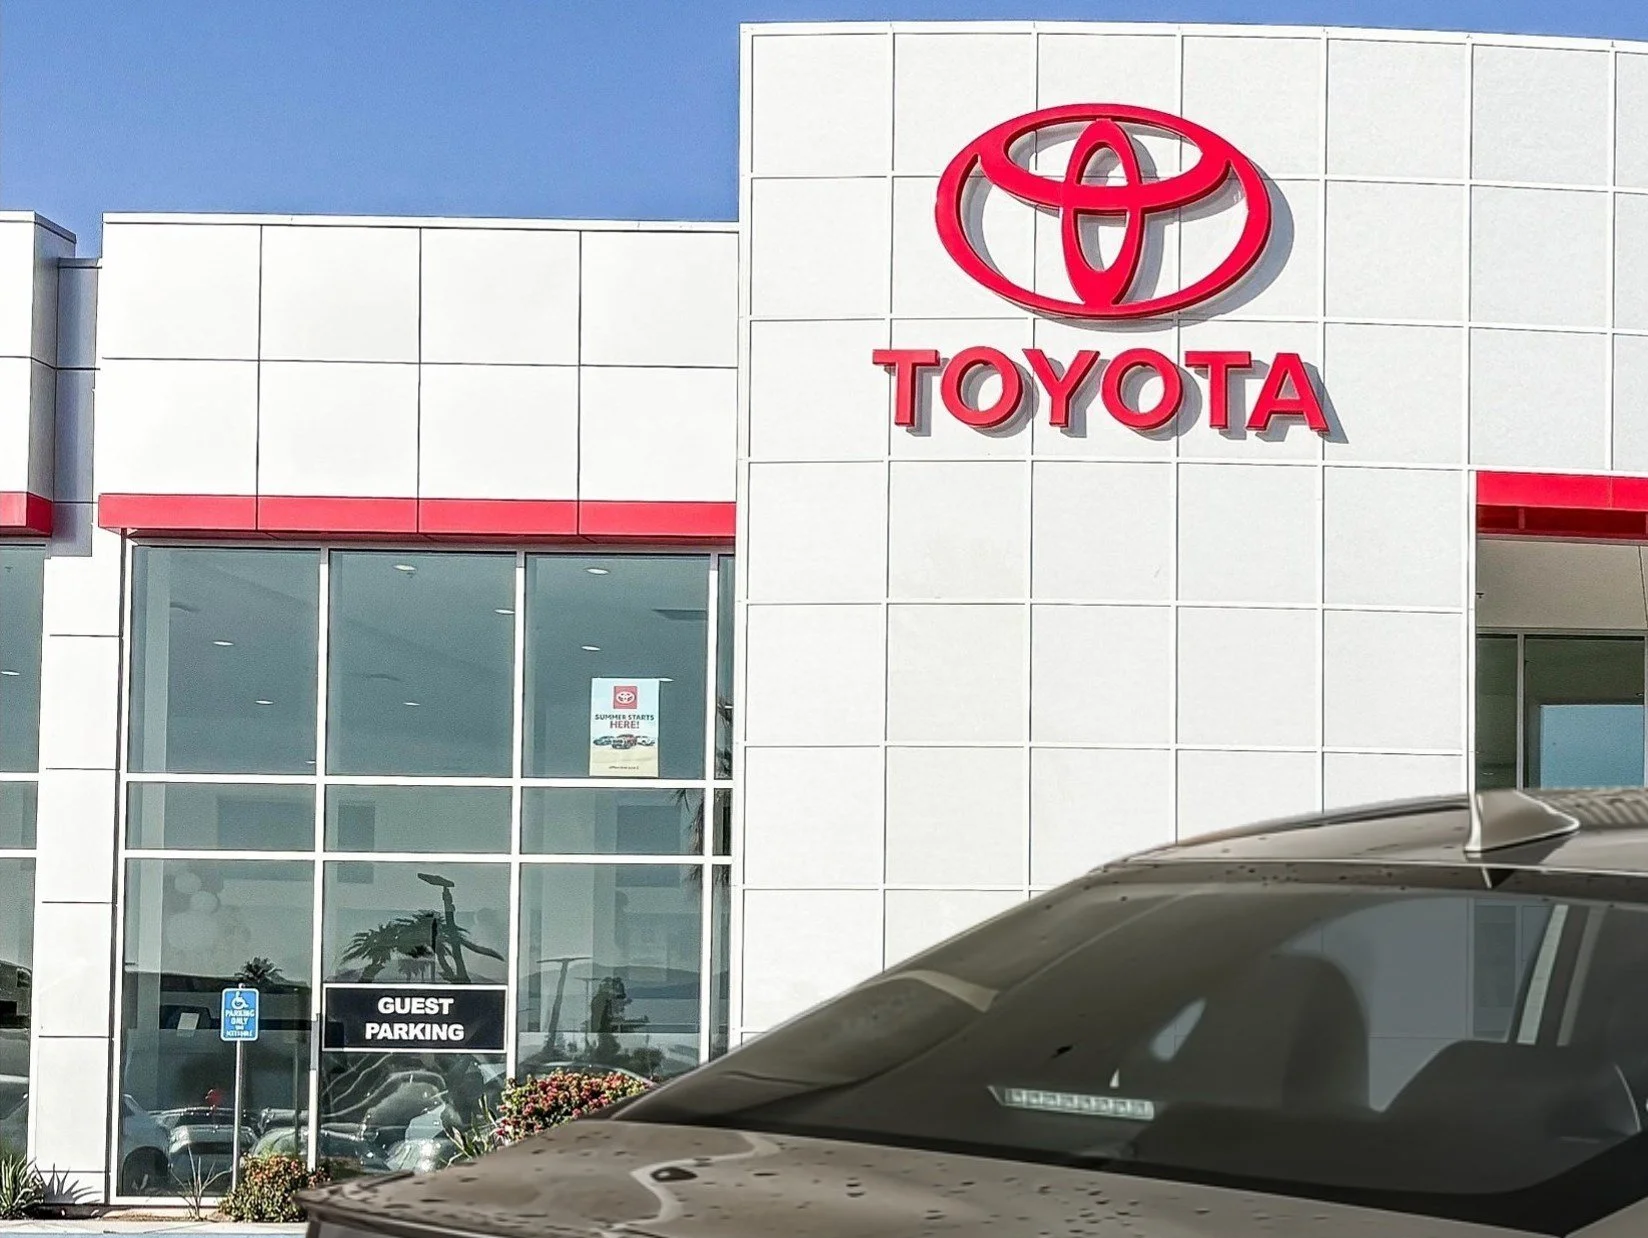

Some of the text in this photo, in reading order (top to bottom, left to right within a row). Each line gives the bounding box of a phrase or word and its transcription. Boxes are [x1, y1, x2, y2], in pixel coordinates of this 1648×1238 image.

[873, 345, 1330, 433] TOYOTA
[609, 720, 640, 729] HERE!
[377, 996, 455, 1015] GUEST
[225, 1009, 255, 1018] PARKING
[231, 1016, 249, 1025] ONLY
[364, 1022, 465, 1042] PARKING
